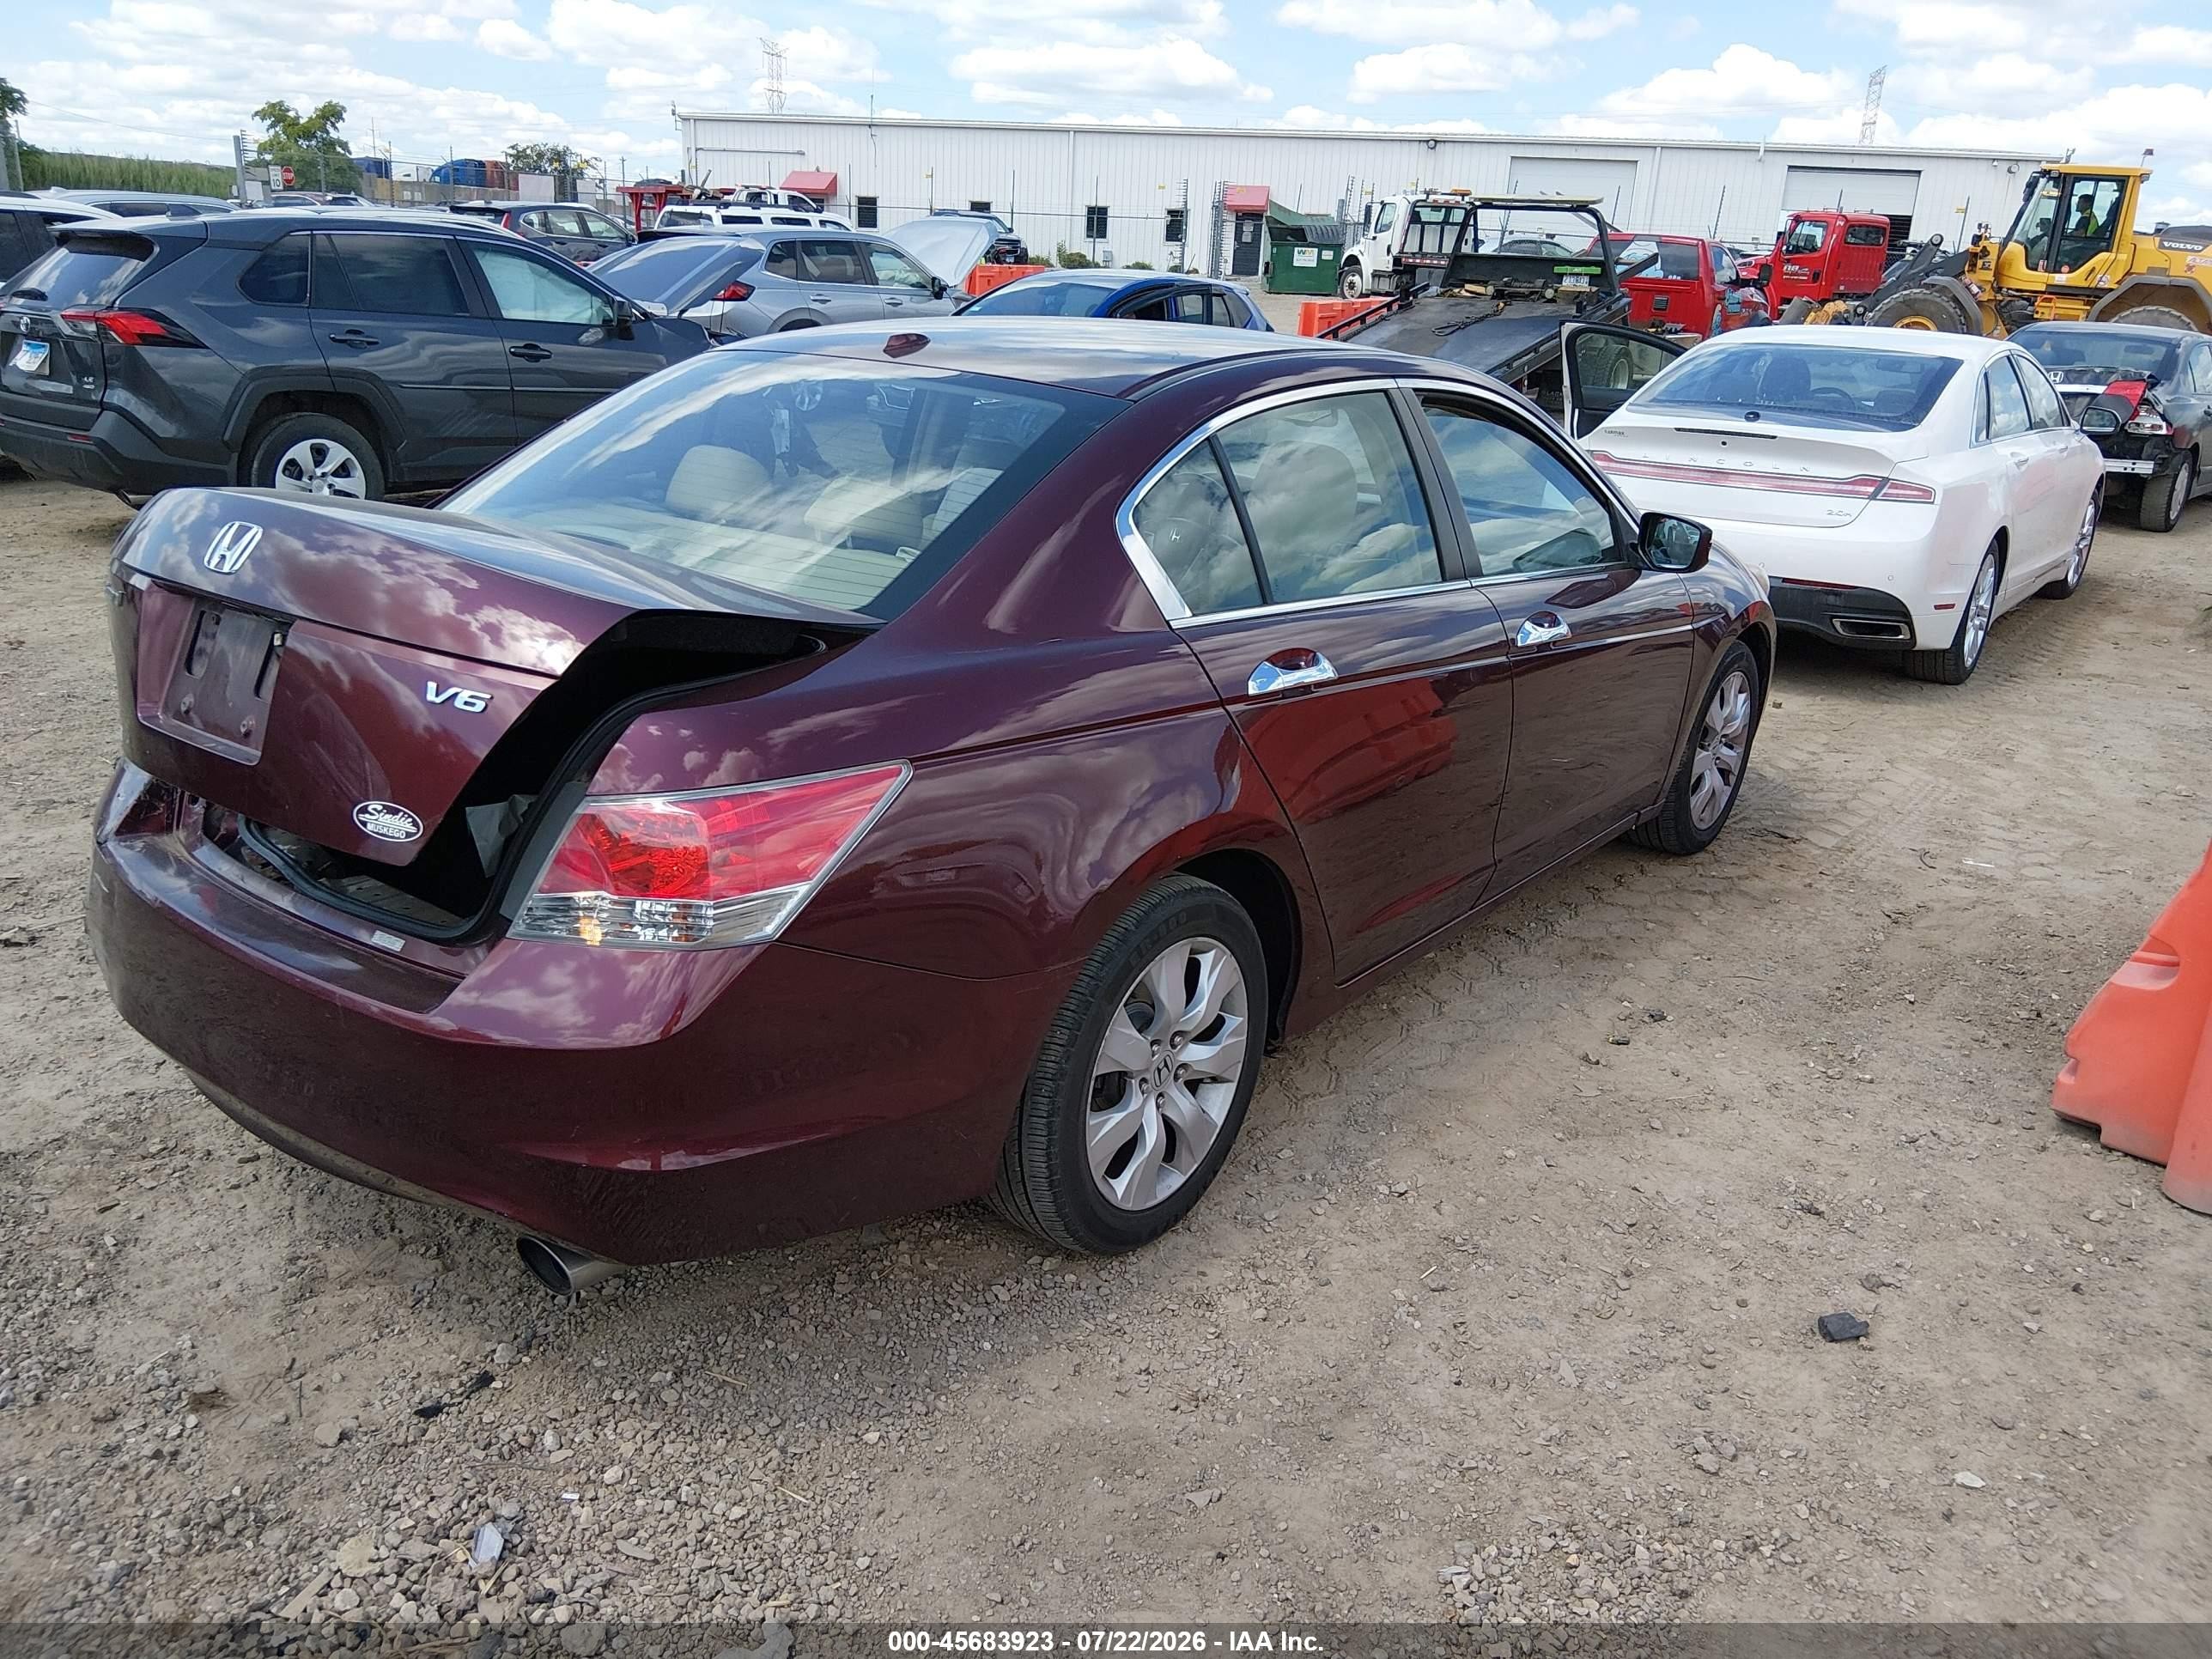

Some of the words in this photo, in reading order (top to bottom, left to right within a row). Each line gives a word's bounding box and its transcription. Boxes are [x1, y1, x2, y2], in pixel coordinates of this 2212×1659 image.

[272, 178, 281, 187] 10
[283, 172, 294, 180] STOP
[2162, 241, 2204, 251] VOLVO
[1642, 452, 1811, 472] LINCOLN
[426, 680, 492, 713] V6
[367, 823, 406, 839] MUSKEGO
